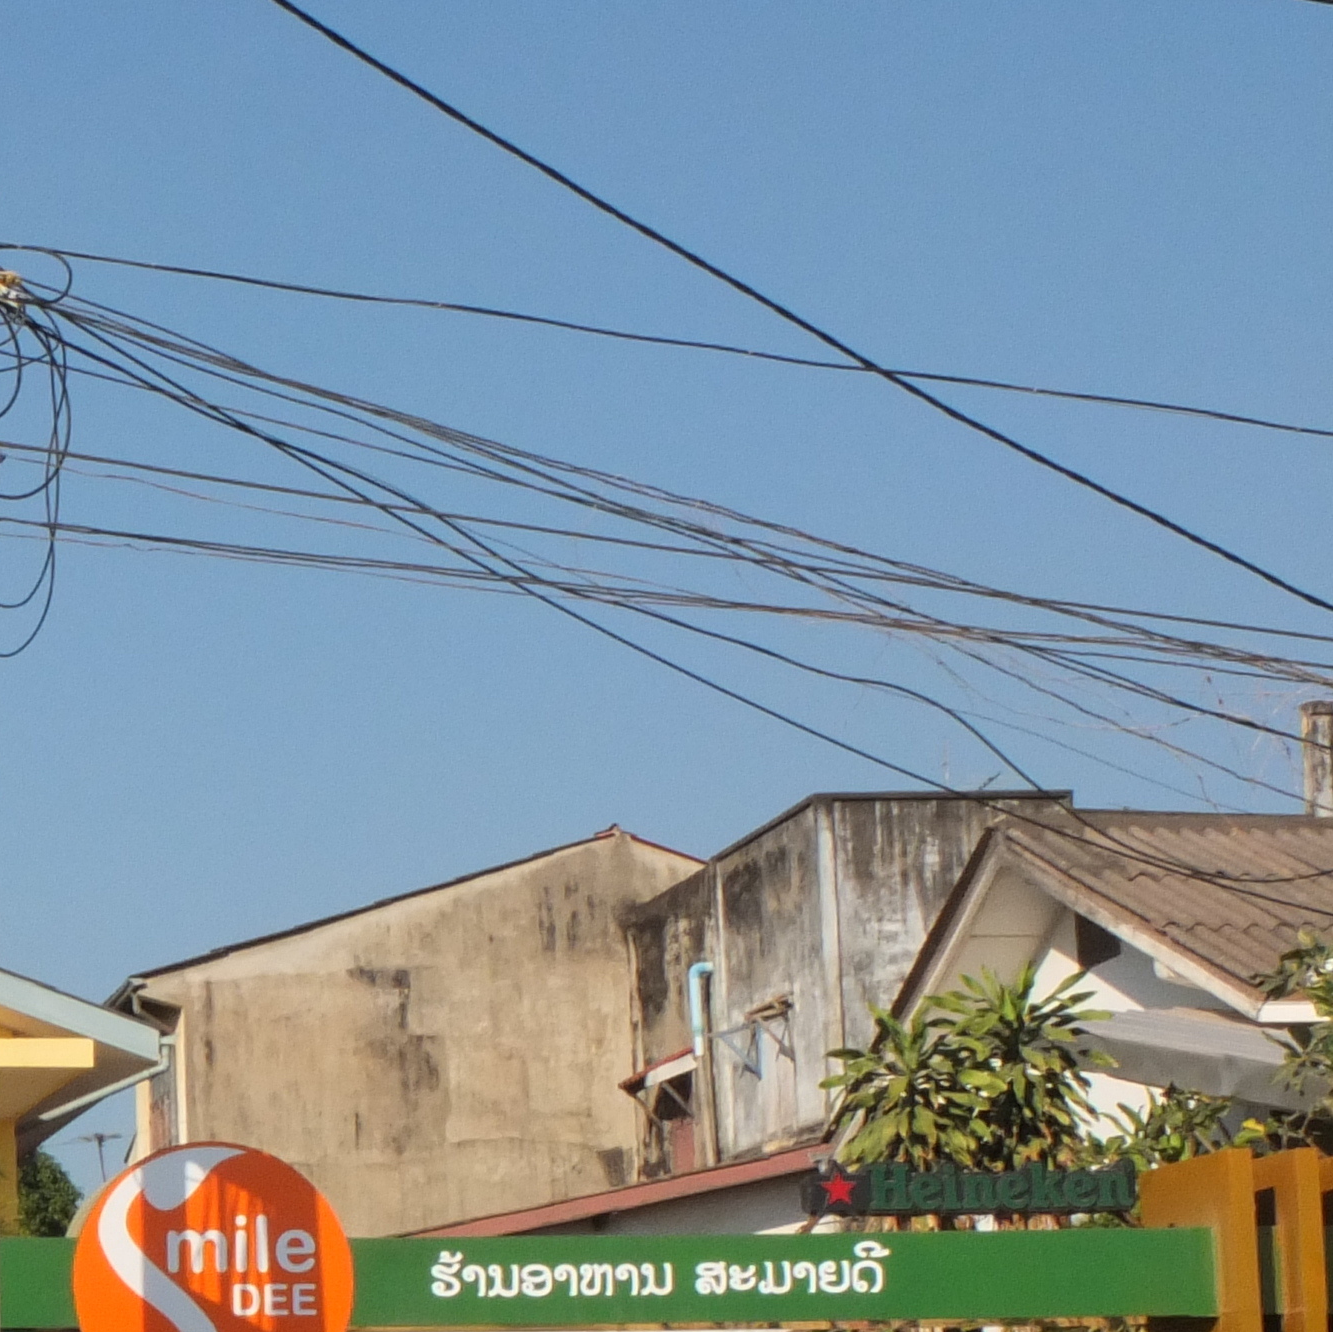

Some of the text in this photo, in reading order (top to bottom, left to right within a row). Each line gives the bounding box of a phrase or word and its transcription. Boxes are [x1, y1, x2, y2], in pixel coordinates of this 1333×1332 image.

[870, 1161, 1132, 1211] Heineken
[430, 1240, 891, 1297] ຮ້ານອາຫານ ສະມາຍດີ
[232, 1282, 318, 1317] DEE
